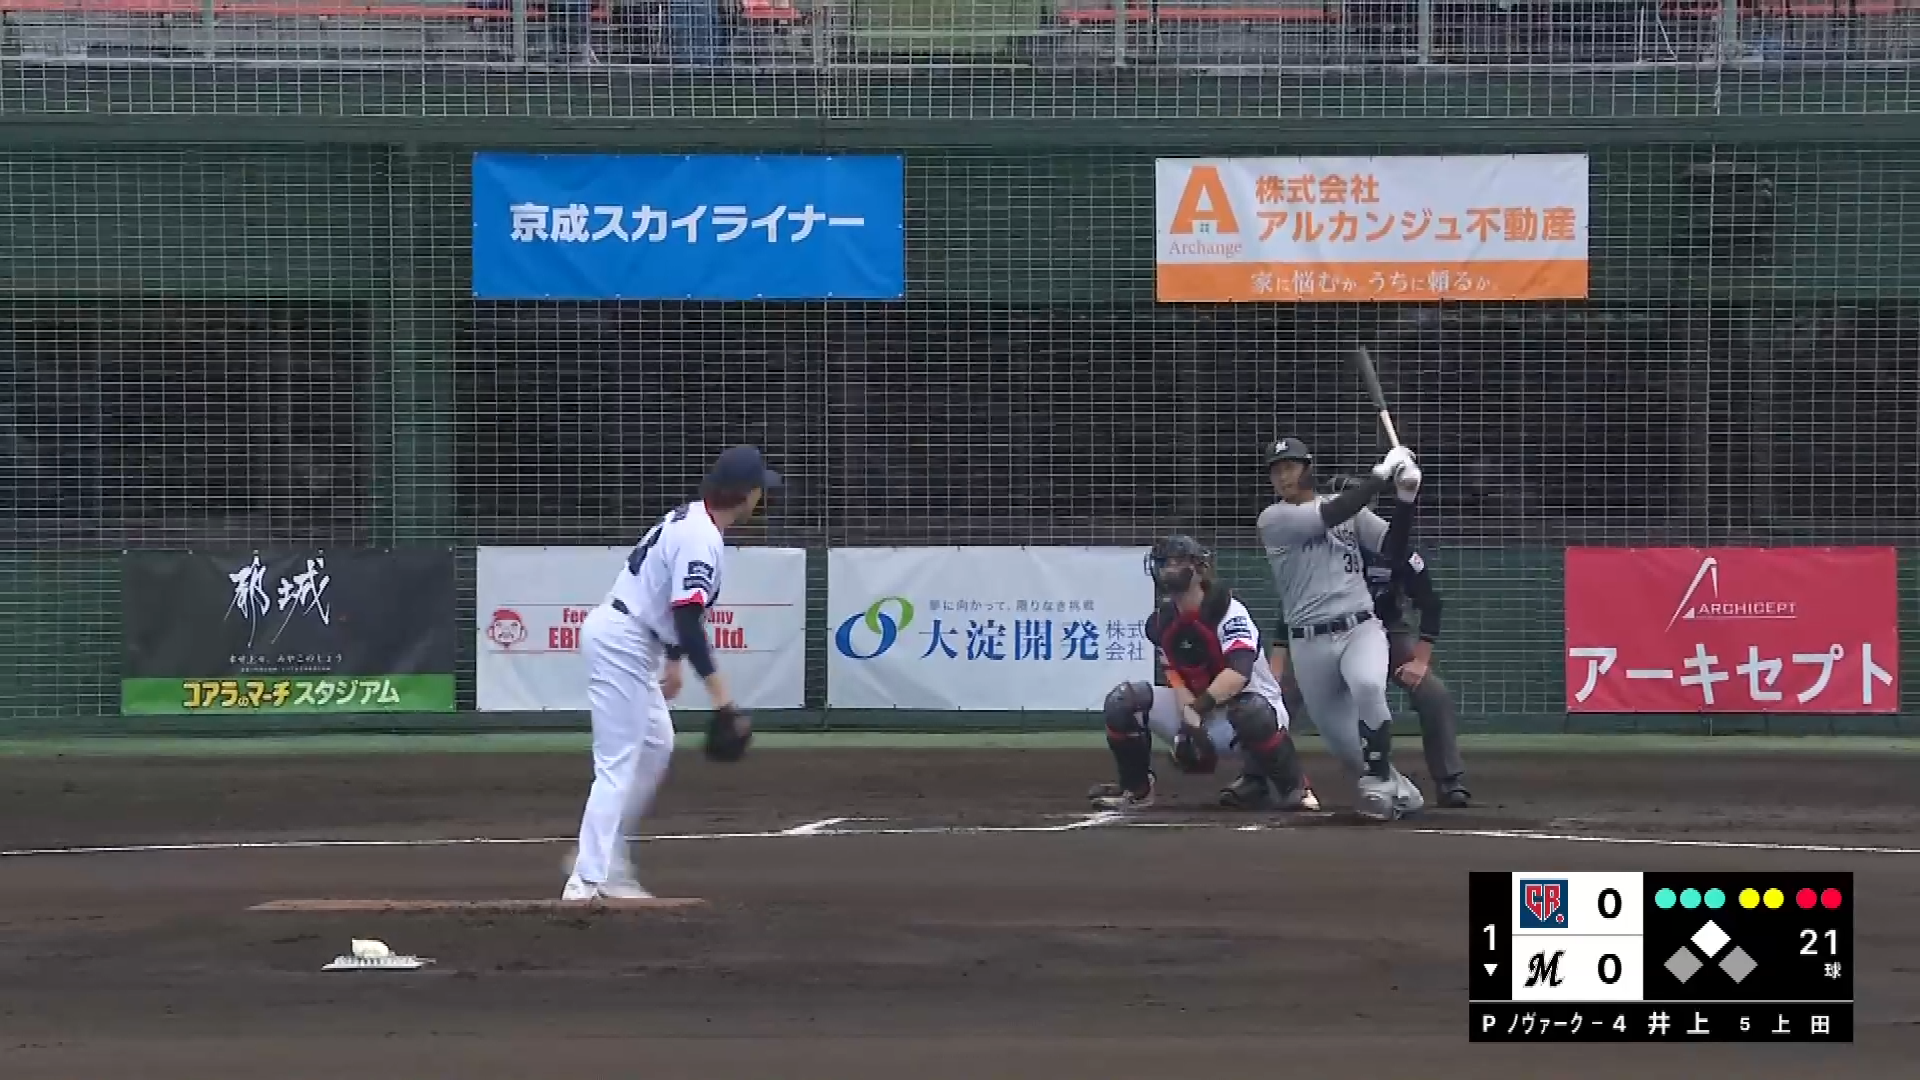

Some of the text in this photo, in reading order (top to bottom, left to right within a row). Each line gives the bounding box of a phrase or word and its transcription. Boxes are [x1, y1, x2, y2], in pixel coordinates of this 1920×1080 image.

[1169, 165, 1240, 235] A
[1255, 174, 1380, 204] 株式会社
[509, 203, 865, 243] 京成スカイライナー
[1256, 206, 1577, 243] アルカンジュ不動産
[1699, 602, 1797, 615] ARCHICEPT
[919, 619, 1099, 660] 大淀開発
[1105, 619, 1146, 640] 株式
[1105, 641, 1146, 661] 会社
[1569, 643, 1894, 705] アーキセプト
[294, 680, 400, 704] スタジアム
